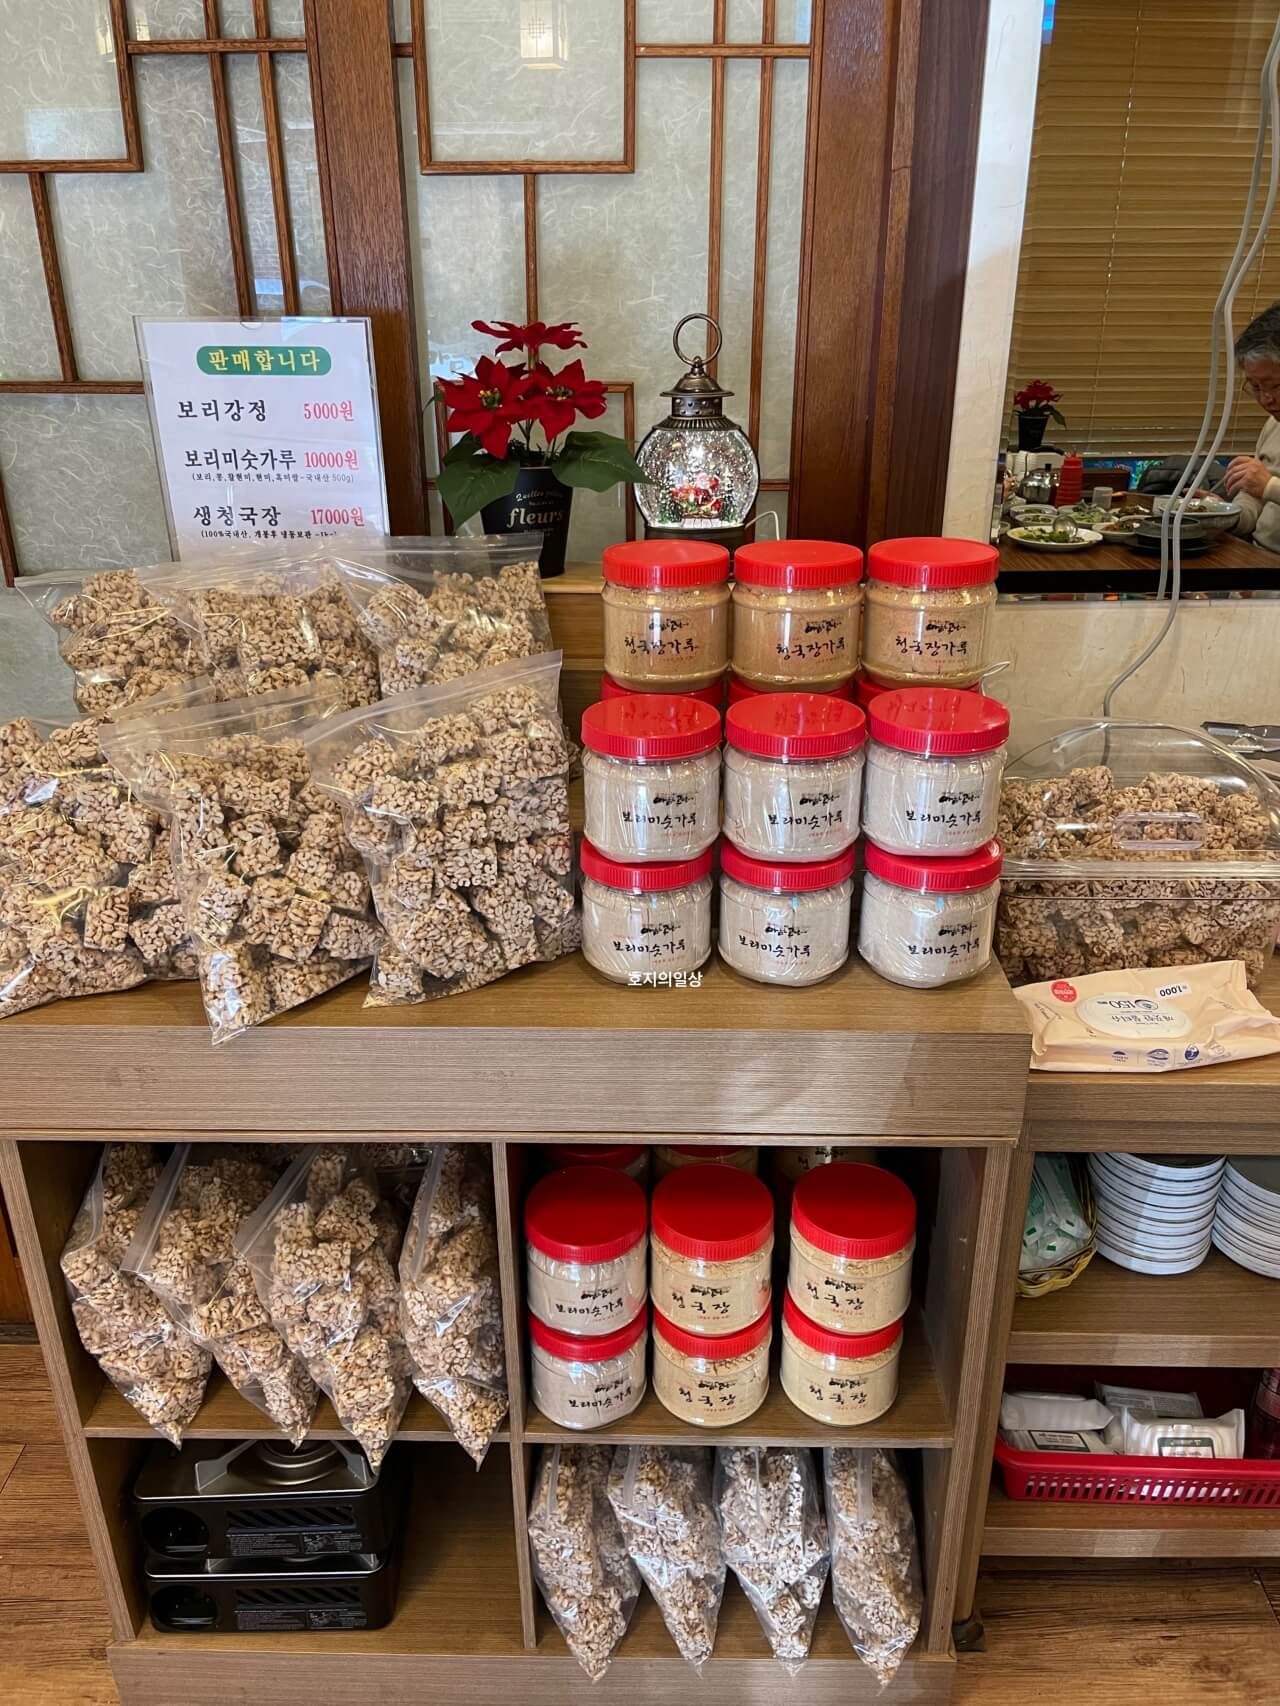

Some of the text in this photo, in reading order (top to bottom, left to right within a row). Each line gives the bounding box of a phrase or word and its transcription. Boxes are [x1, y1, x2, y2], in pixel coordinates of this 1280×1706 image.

[208, 349, 321, 372] 판매합니다
[177, 399, 355, 422] 보리강정 5000원
[184, 448, 359, 471] 보리미숫가루 10000원
[193, 506, 365, 527] 생청국장 17000원
[506, 507, 563, 528] fleurs
[624, 635, 699, 656] 청국장가루
[776, 636, 846, 661] 청국장가루
[895, 635, 969, 657] 청국장가루
[622, 810, 697, 830] 보리미숫가루
[768, 810, 843, 830] 보리미숫가루
[905, 810, 982, 829] 보리미숫가루
[613, 938, 686, 957] 보리미숫가루
[738, 934, 811, 958] 보리미숫가루
[907, 937, 980, 958] 보리미숫가루
